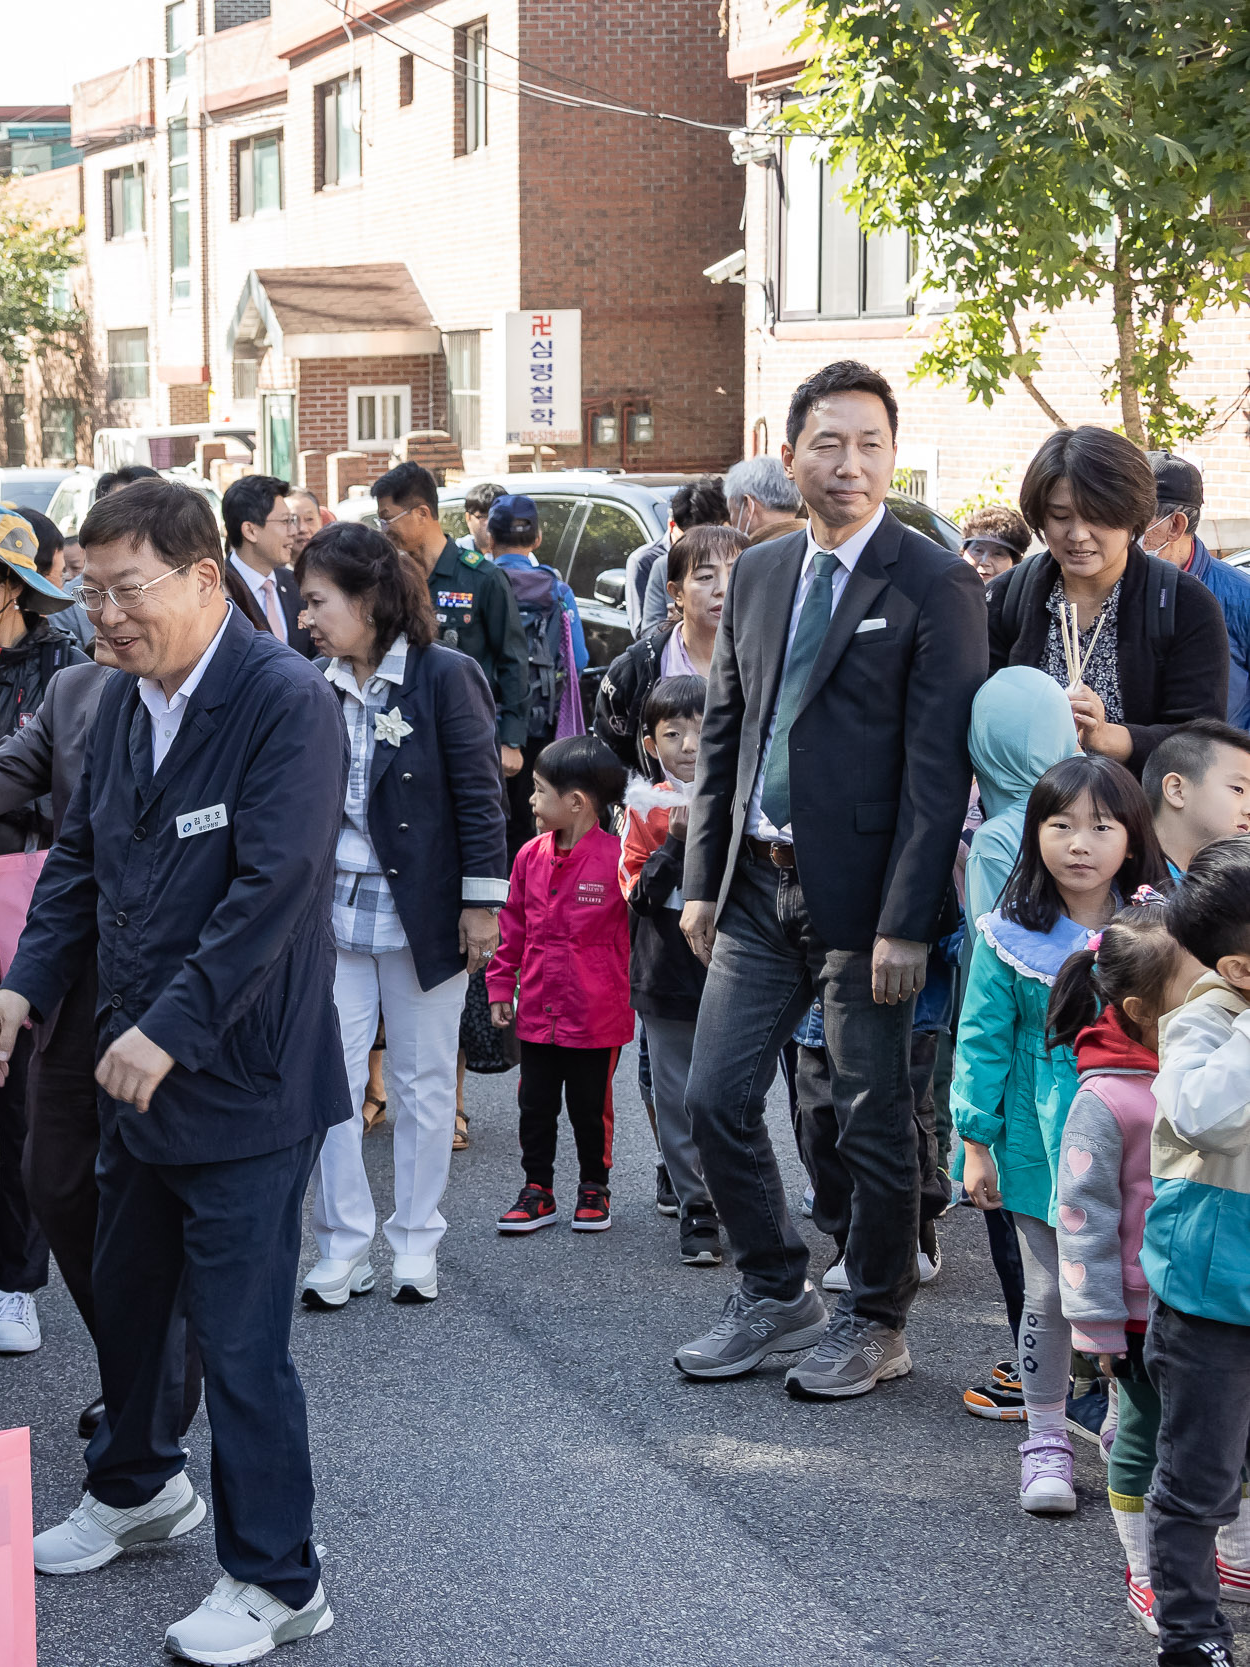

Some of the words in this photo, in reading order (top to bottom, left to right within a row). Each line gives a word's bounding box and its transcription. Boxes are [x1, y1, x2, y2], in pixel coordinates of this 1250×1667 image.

[750, 1318, 777, 1338] N
[863, 1341, 885, 1361] N
[1042, 1437, 1066, 1447] FILA
